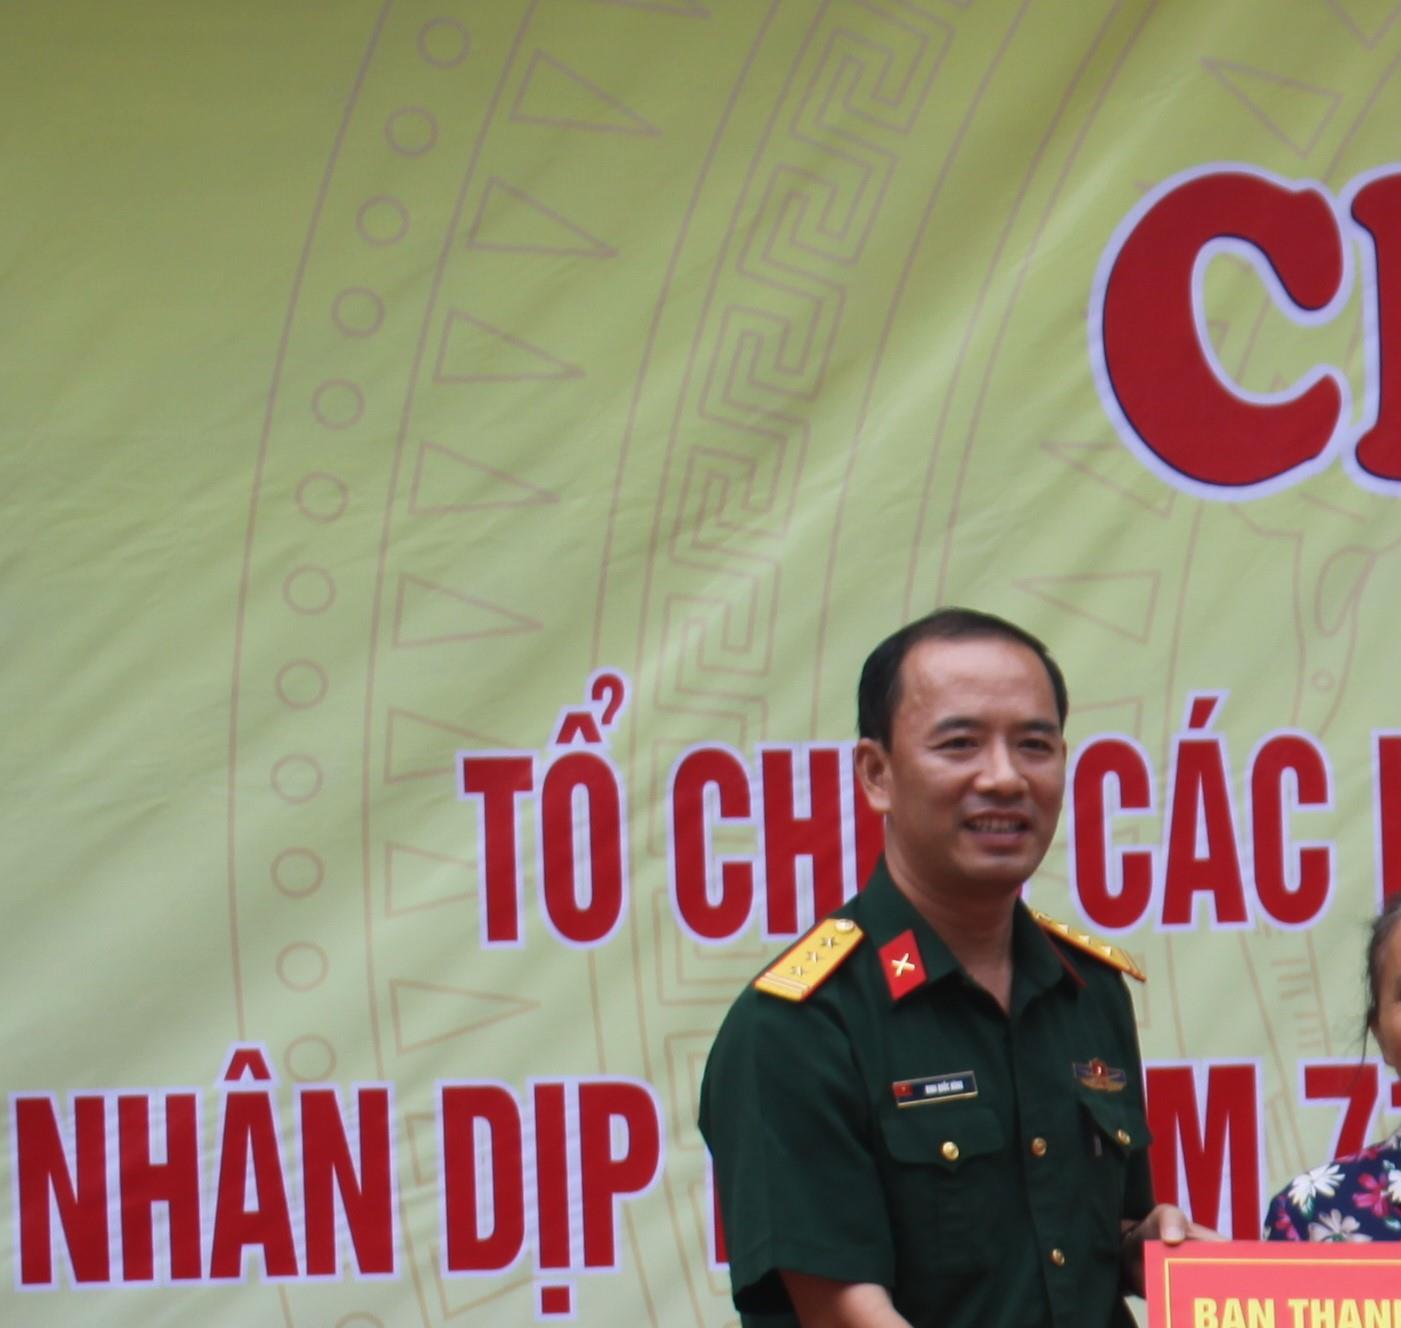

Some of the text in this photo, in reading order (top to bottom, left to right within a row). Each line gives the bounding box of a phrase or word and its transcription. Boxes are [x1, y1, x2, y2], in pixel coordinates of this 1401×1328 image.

[461, 672, 626, 945] TỔ
[672, 746, 886, 939] CH
[1072, 695, 1332, 932] CÁC
[15, 1047, 396, 1287] NHÂN
[440, 1080, 662, 1316] DỊP
